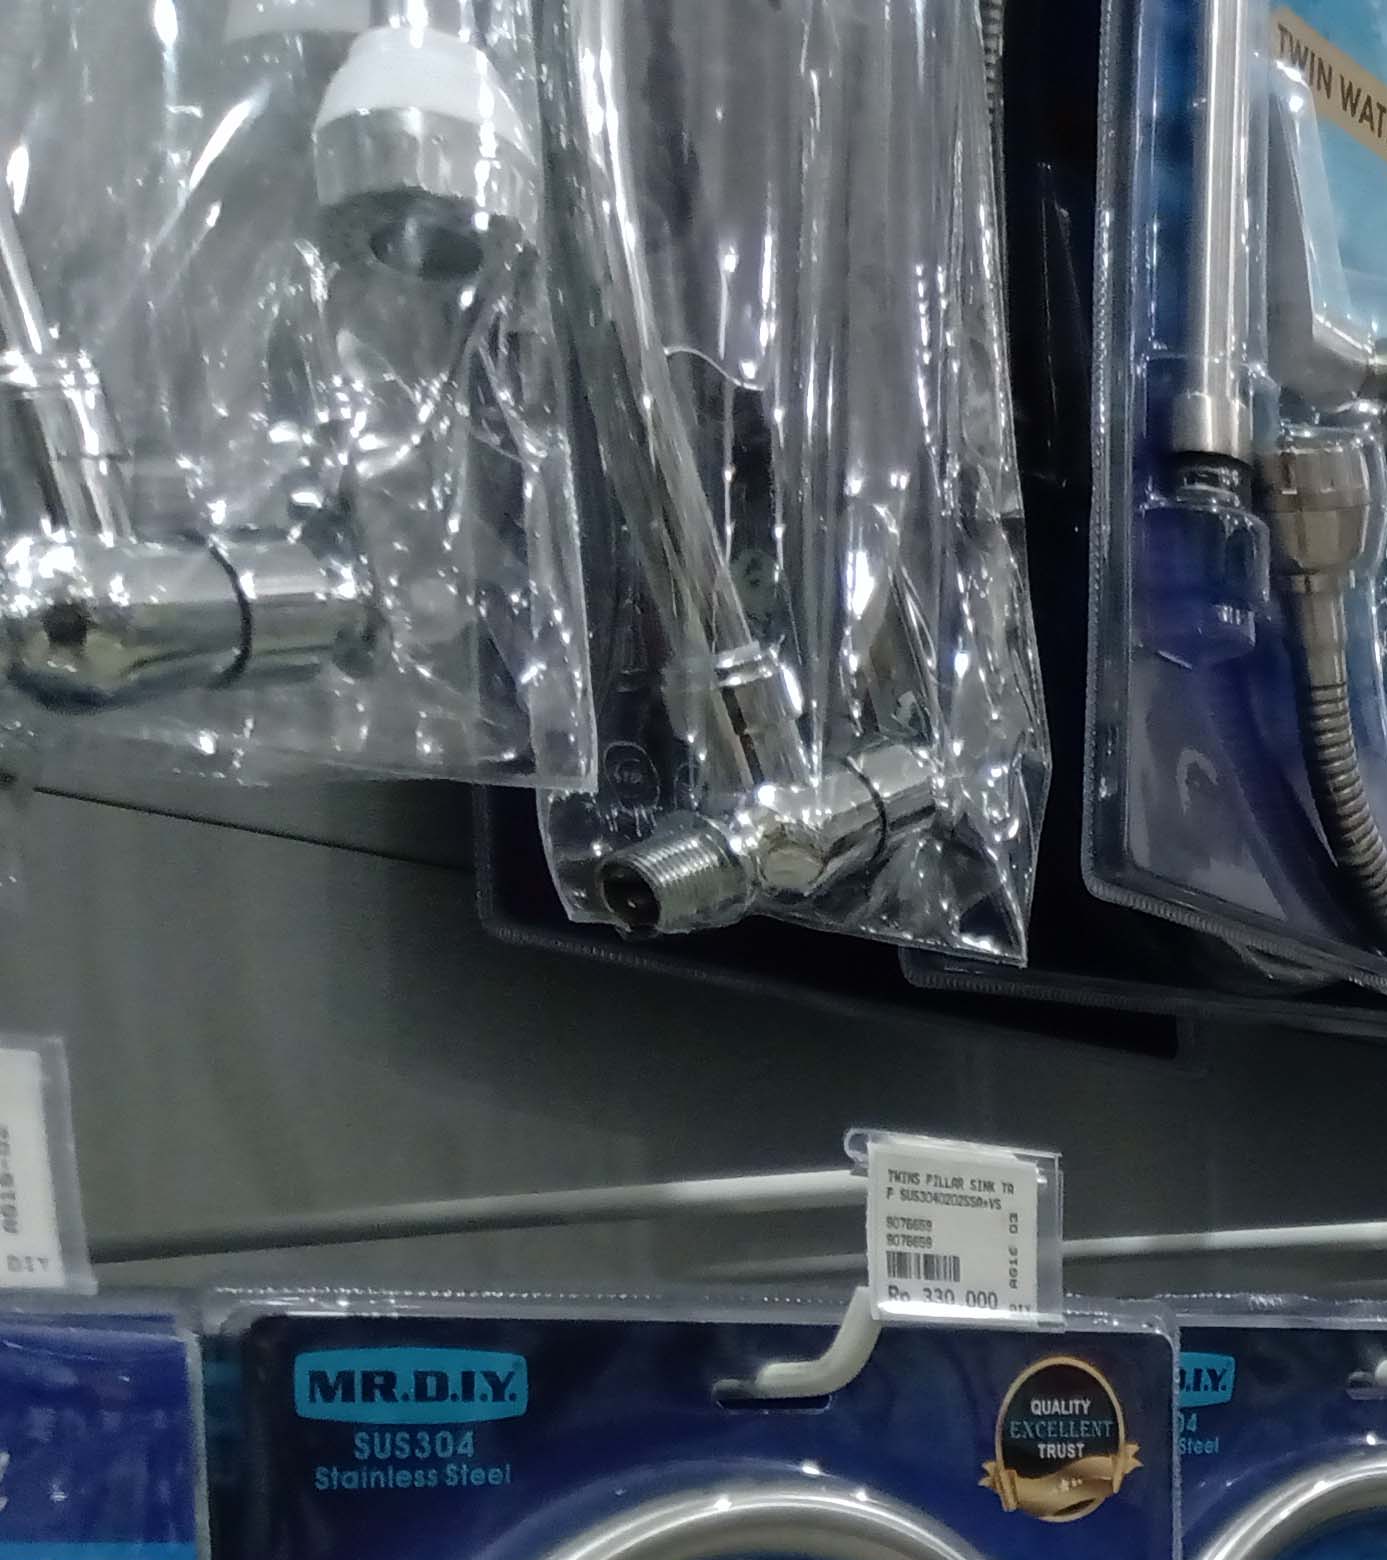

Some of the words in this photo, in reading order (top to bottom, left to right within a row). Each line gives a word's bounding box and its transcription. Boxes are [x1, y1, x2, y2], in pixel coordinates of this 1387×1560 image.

[1278, 22, 1332, 100] TWIN
[887, 1169, 920, 1185] TWINS
[925, 1173, 964, 1190] PILLAR
[970, 1179, 996, 1193] SINK
[307, 1369, 518, 1403] MR.D.I.Y.
[1031, 1399, 1091, 1416] QUALITY
[1009, 1420, 1114, 1440] EXCELLENT
[354, 1431, 475, 1460] SUS304
[1038, 1443, 1086, 1459] TRUST
[315, 1466, 438, 1490] Stainless
[446, 1464, 512, 1486] Steel
